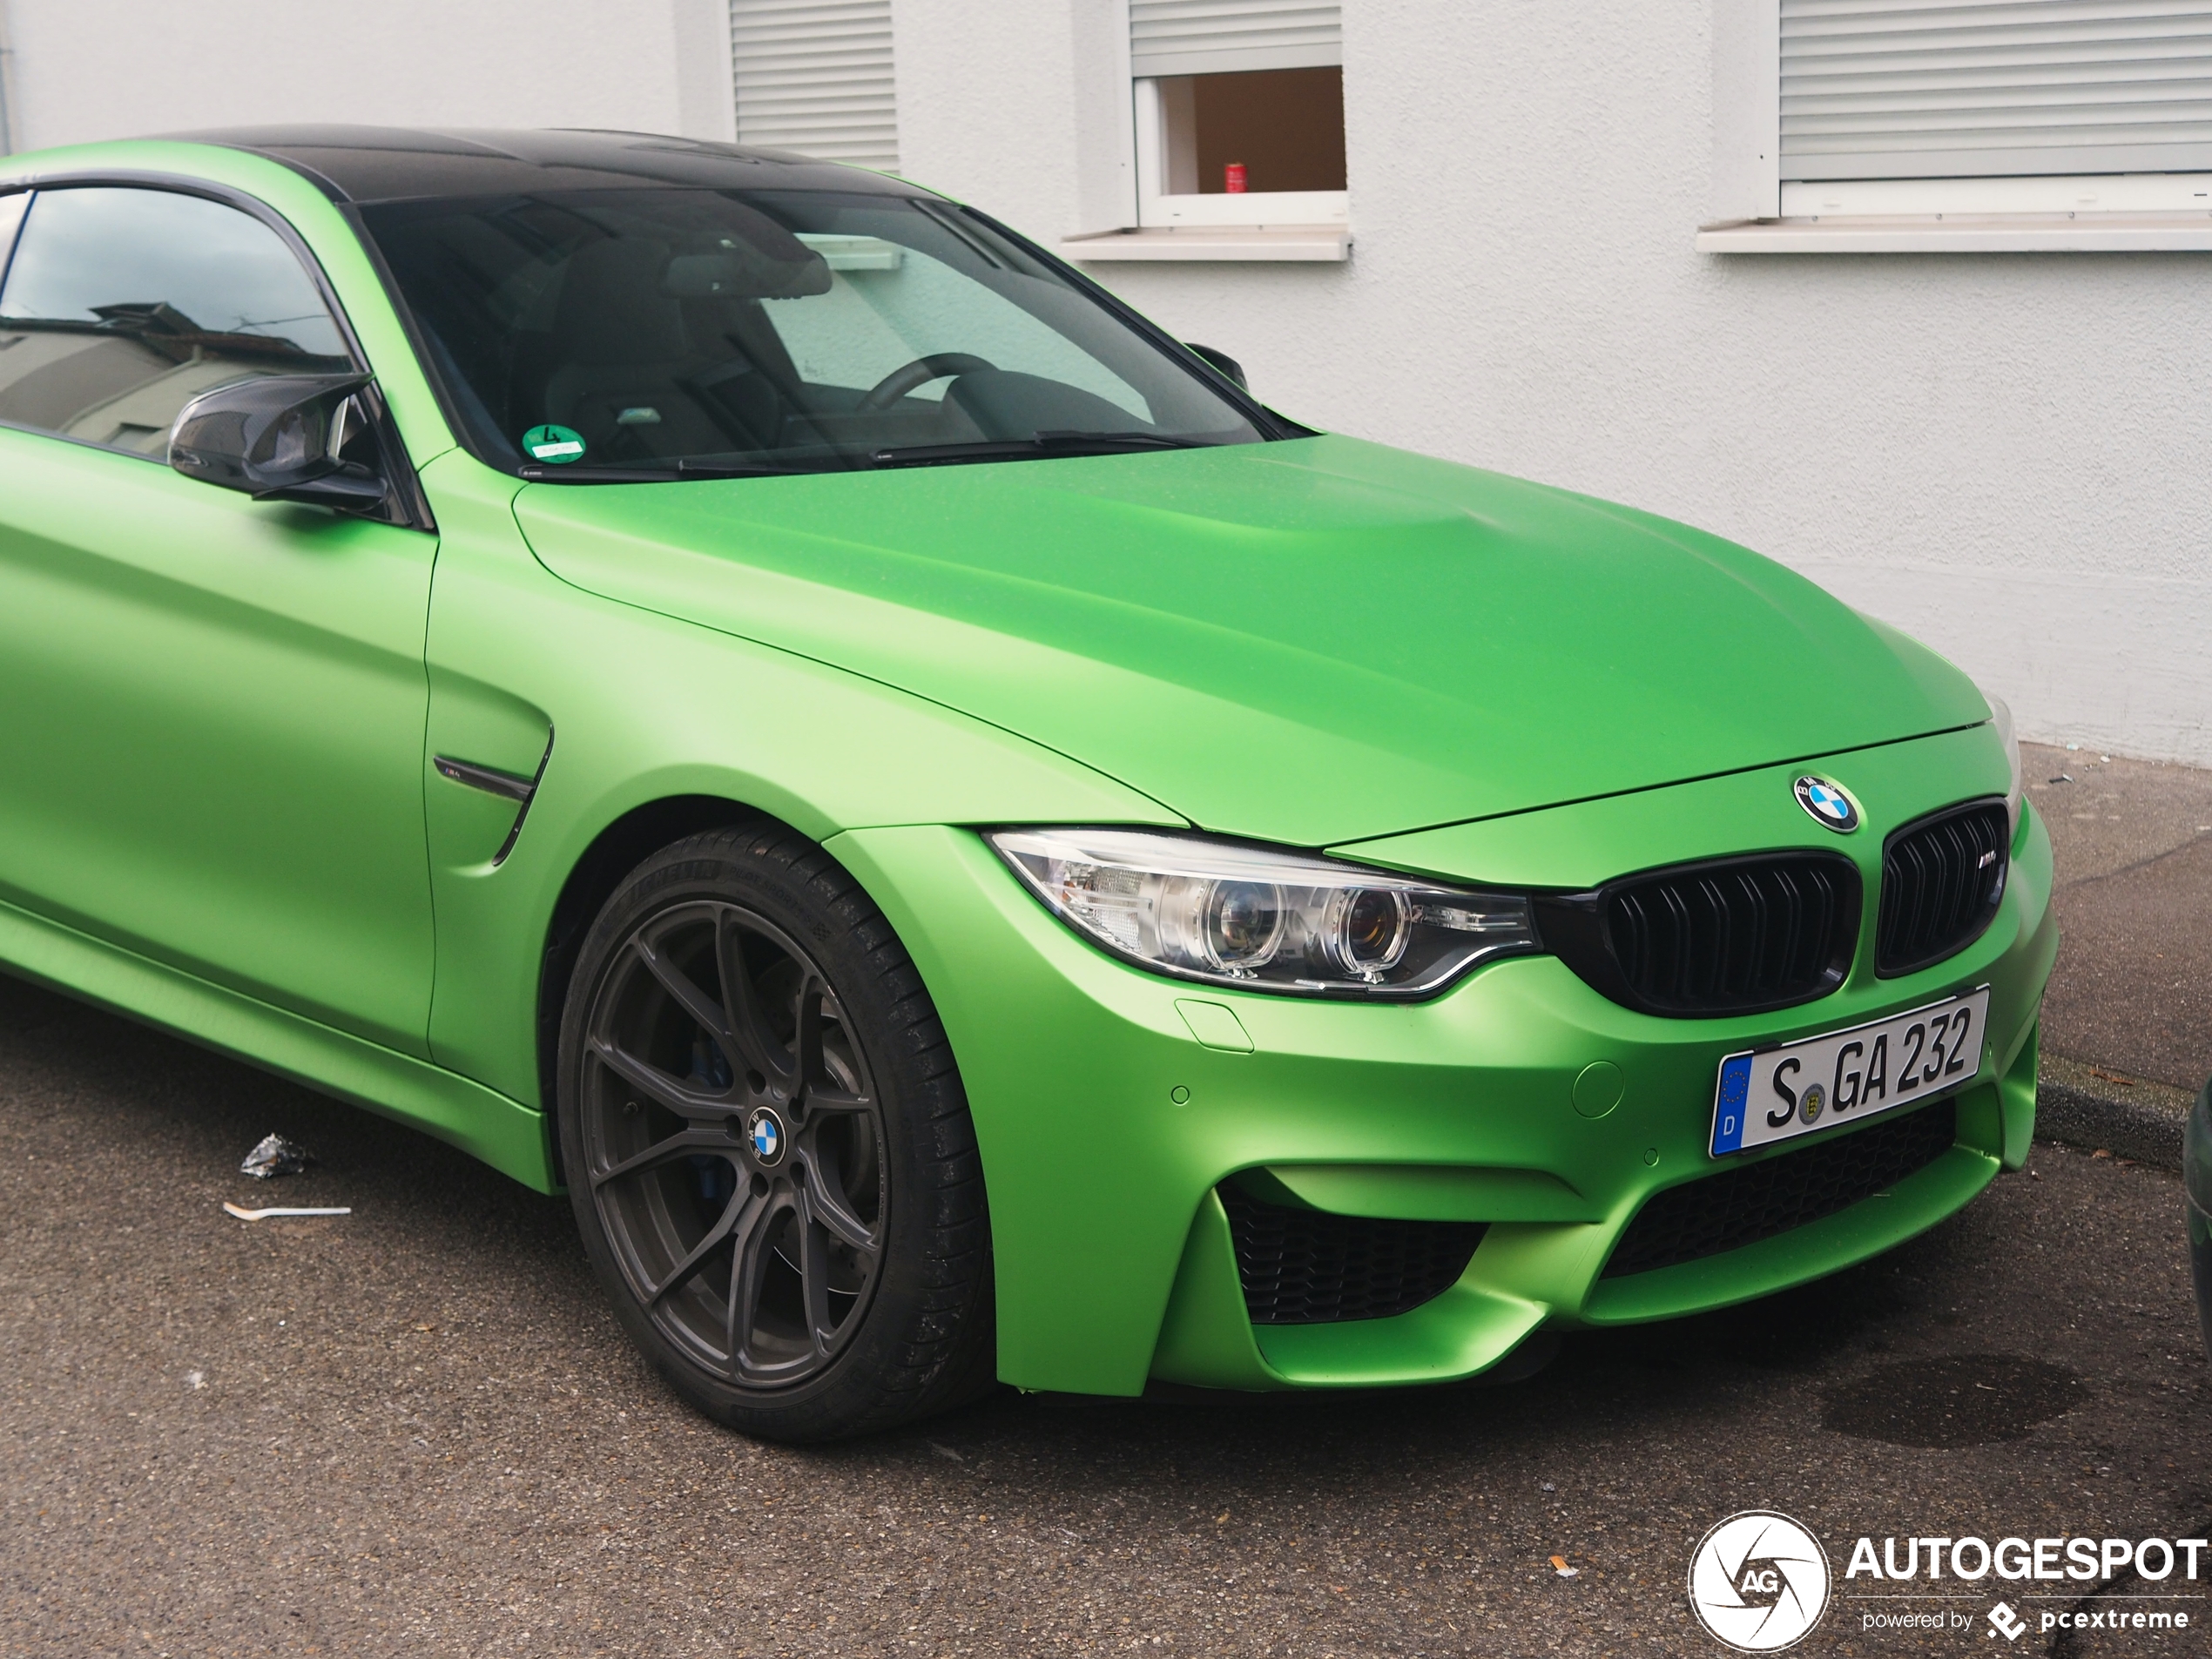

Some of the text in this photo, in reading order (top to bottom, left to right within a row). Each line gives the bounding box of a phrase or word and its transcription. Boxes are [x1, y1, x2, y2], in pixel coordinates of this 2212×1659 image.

[544, 427, 560, 442] 4
[1797, 777, 1836, 796] BMW
[1766, 1057, 1801, 1128] S
[1832, 1034, 1888, 1111] GA
[1897, 1007, 1971, 1092] 232
[749, 1112, 762, 1159] BMW
[1723, 1116, 1735, 1136] D
